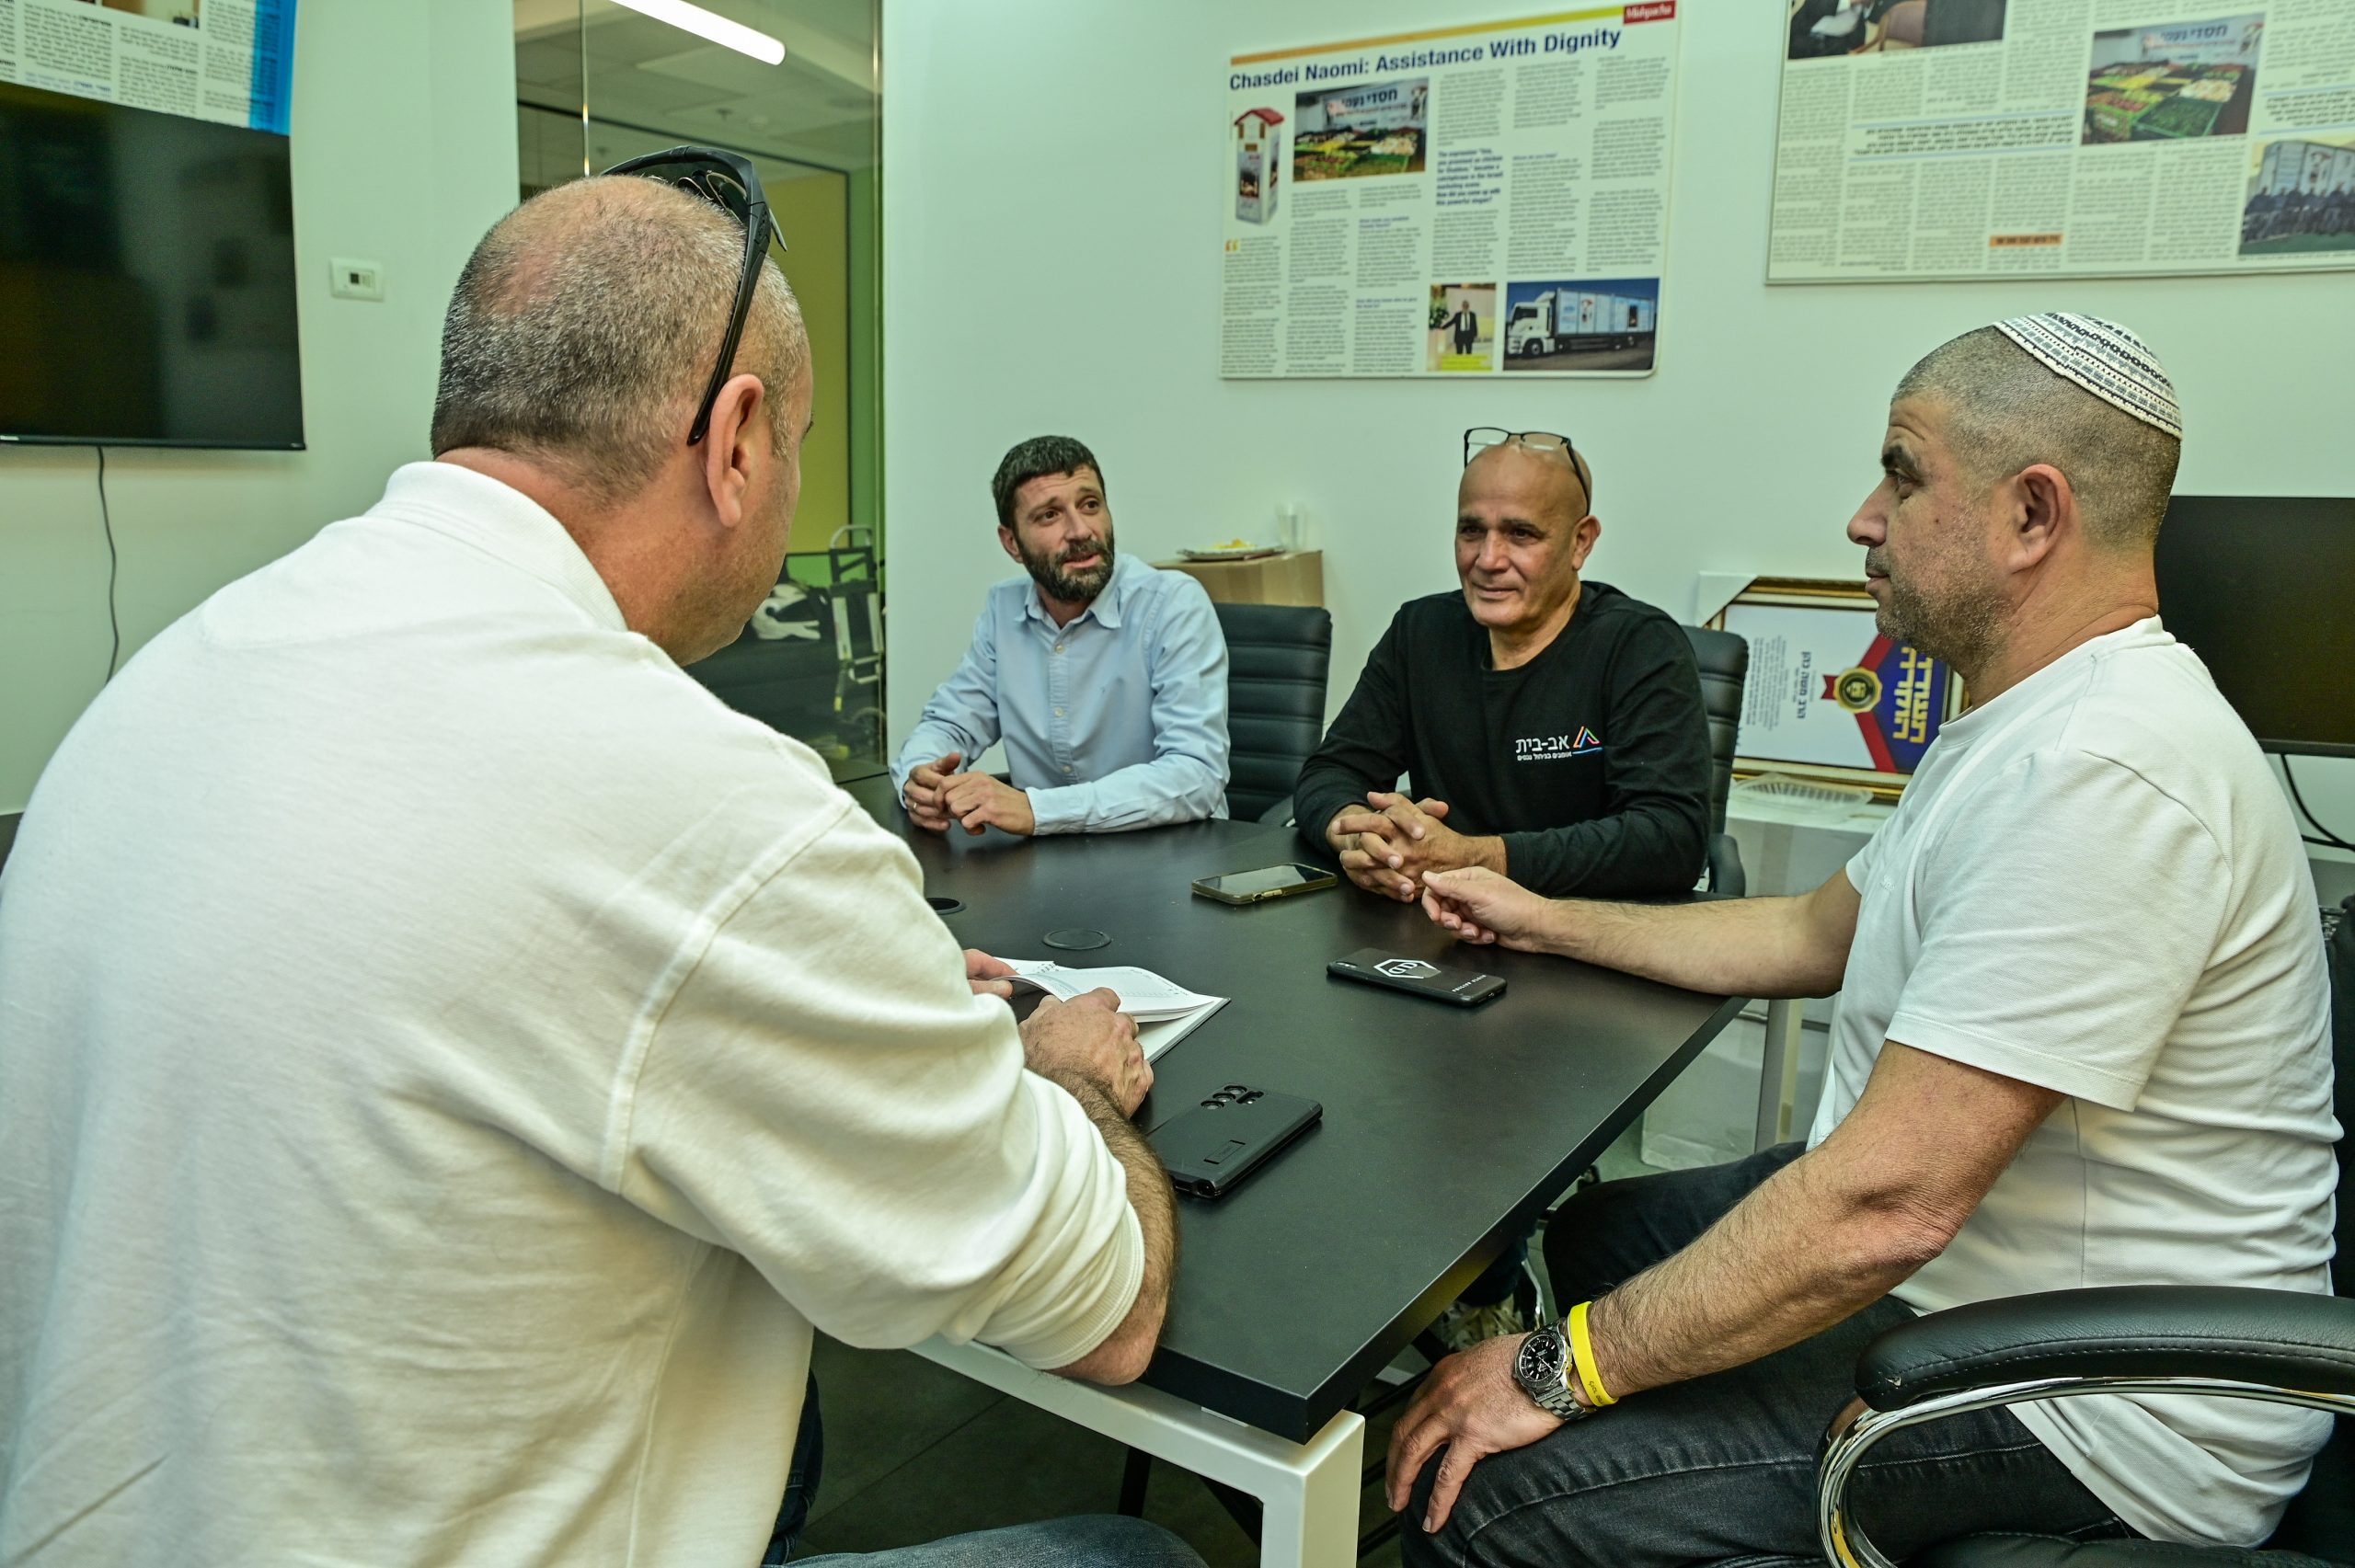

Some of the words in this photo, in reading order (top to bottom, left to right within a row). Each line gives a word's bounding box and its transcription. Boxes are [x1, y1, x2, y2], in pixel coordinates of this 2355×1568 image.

[1229, 65, 1300, 90] Chasdei
[1304, 57, 1370, 81] Naomi:
[1375, 45, 1484, 73] Assistance
[1489, 37, 1536, 59] With
[1544, 29, 1622, 53] Dignity
[1892, 647, 1917, 739] הוקרה
[1515, 735, 1569, 753] אב-בית
